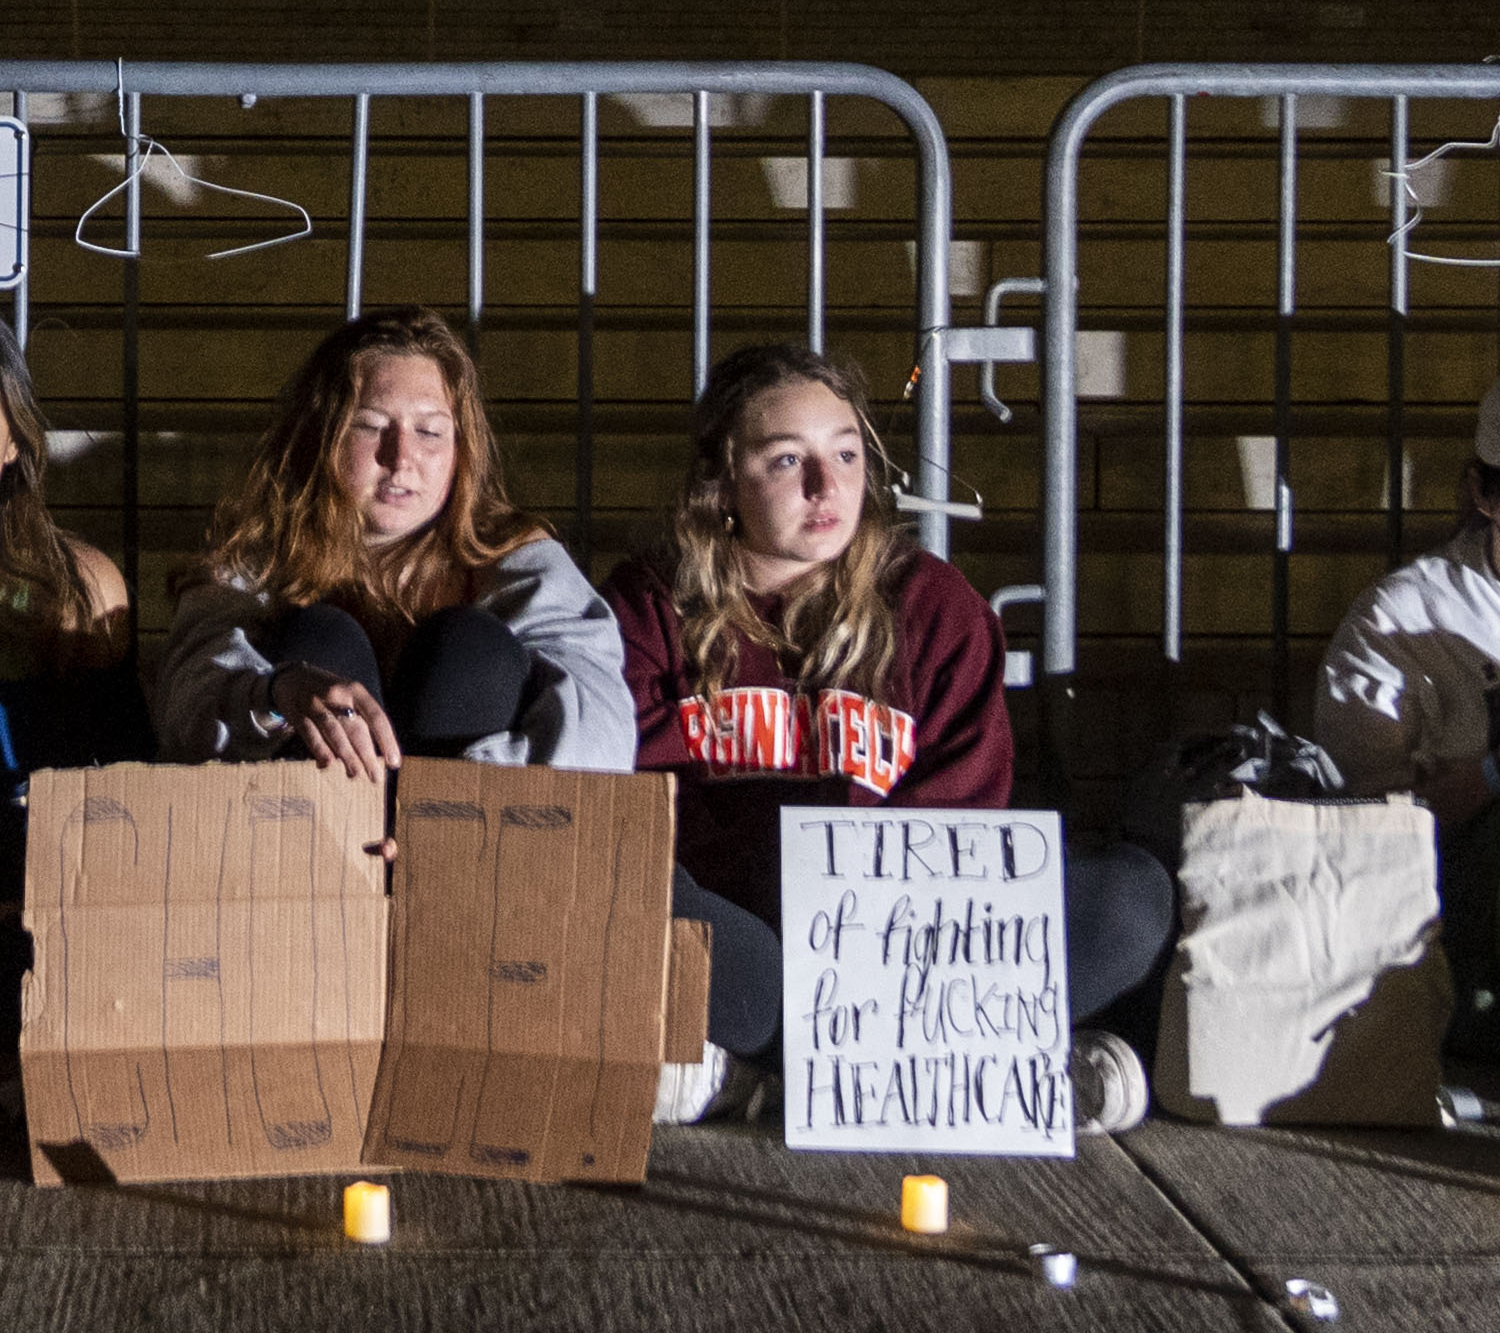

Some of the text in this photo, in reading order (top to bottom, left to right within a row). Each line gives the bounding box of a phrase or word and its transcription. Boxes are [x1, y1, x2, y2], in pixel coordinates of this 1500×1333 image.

[799, 819, 1049, 882] TIRED
[808, 888, 1051, 1002] of fighting
[802, 967, 879, 1051] for
[796, 1049, 1067, 1140] HEALTHCARE
